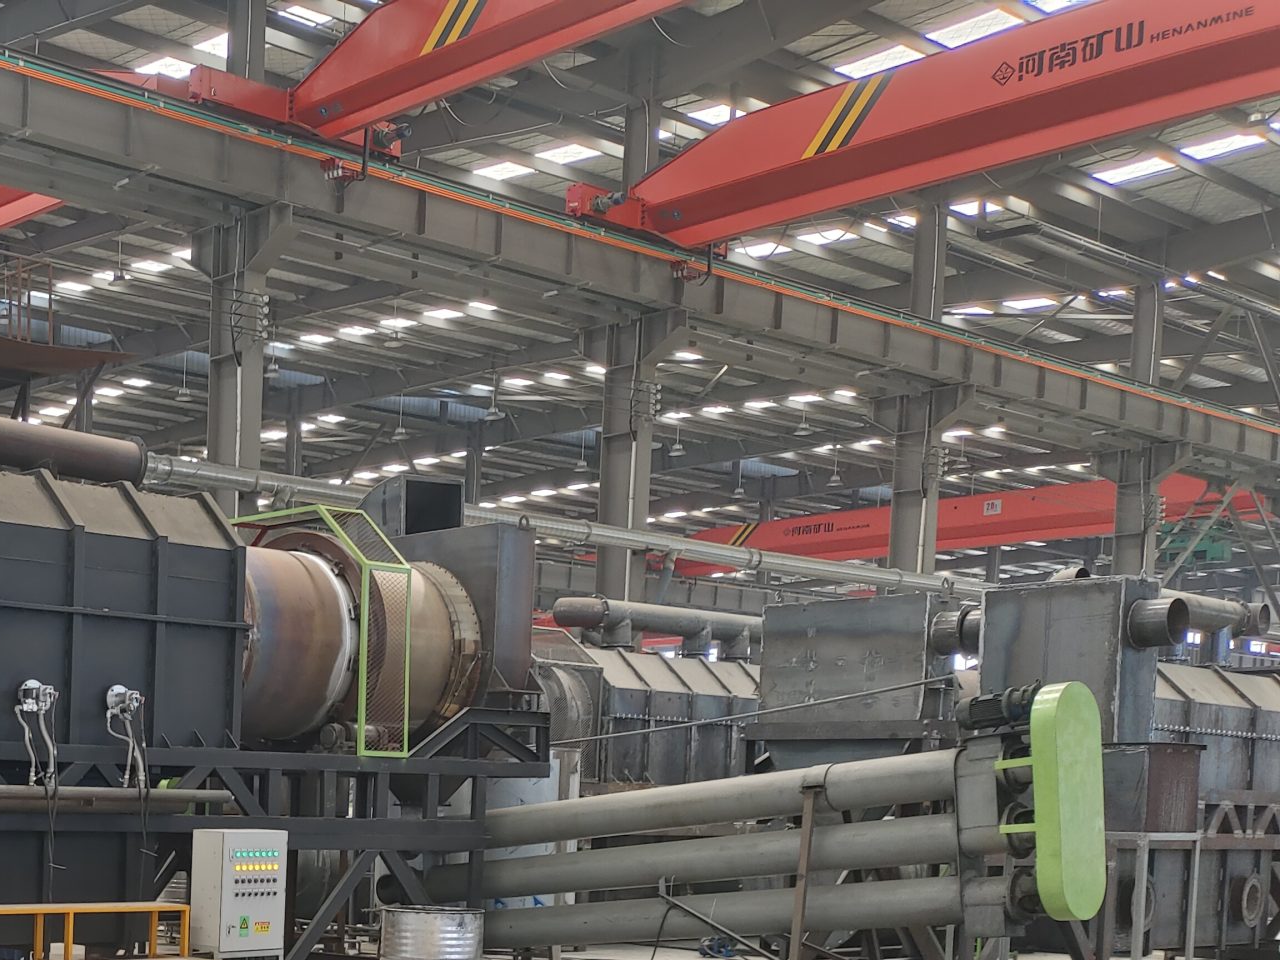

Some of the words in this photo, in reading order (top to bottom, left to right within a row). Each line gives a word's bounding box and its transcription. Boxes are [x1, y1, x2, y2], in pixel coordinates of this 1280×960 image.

[1017, 20, 1144, 81] 河南矿山
[1149, 5, 1254, 43] HENANMINE
